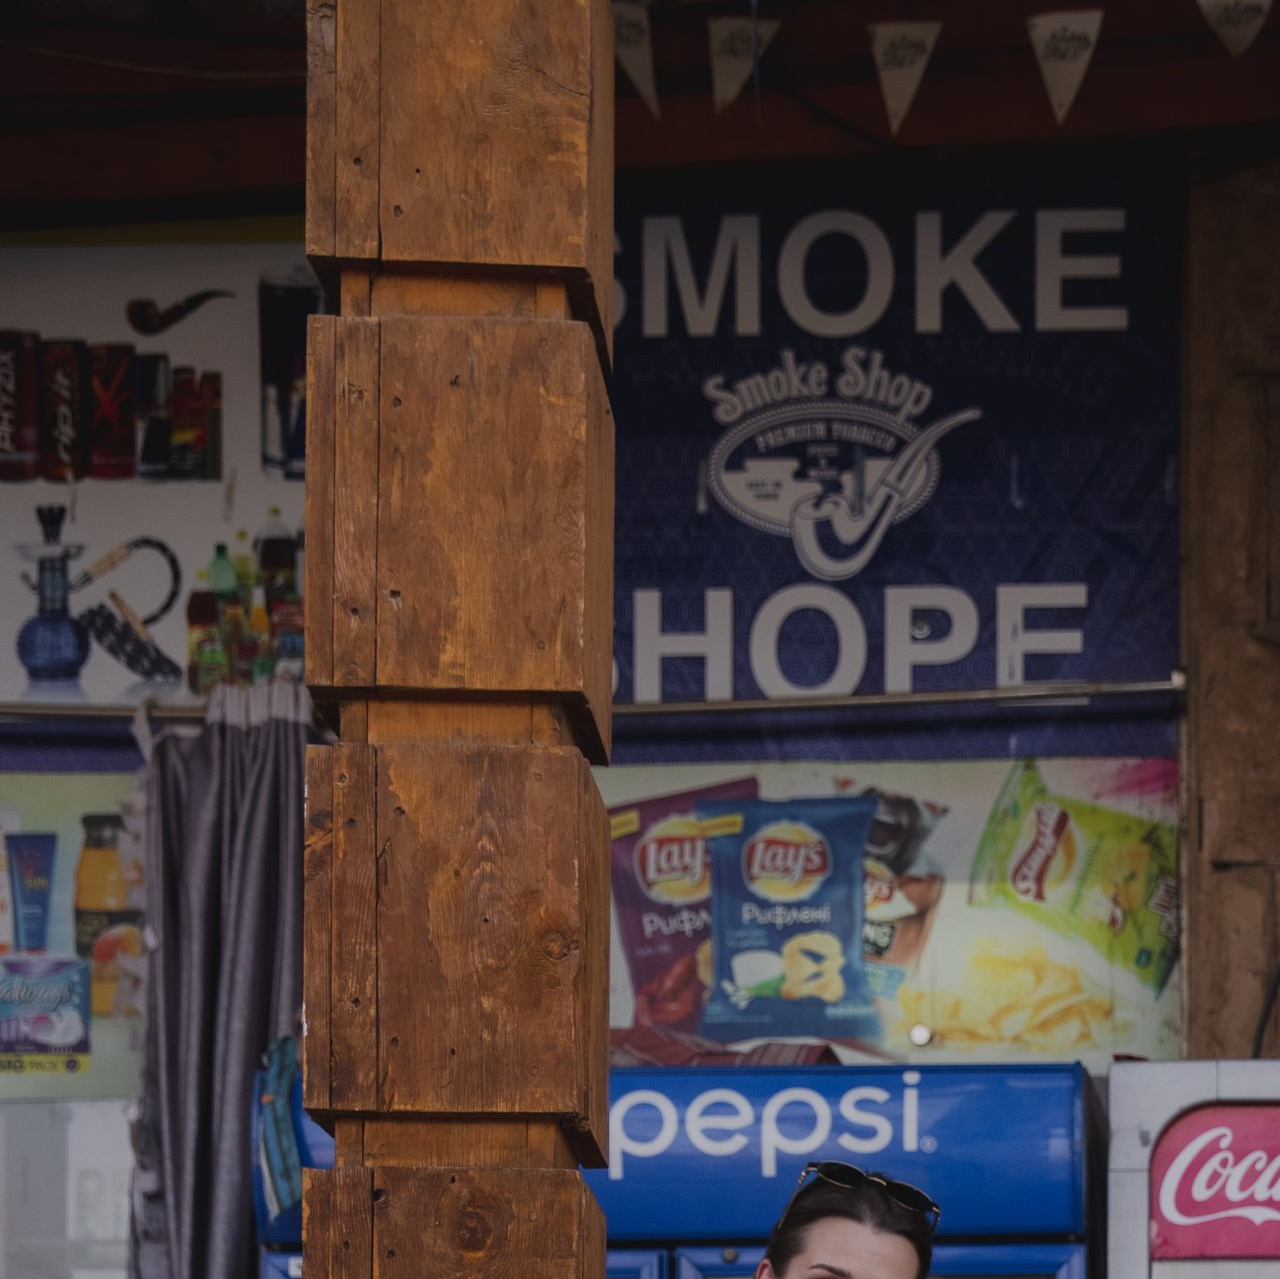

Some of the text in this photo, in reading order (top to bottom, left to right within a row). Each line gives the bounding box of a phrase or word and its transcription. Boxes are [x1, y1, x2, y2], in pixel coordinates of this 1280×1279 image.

[613, 208, 1130, 338] MOKE
[700, 345, 934, 427] Smoke Shop
[613, 582, 1091, 706] HOPE
[645, 837, 712, 886] Lay
[749, 838, 824, 885] Lay's
[641, 907, 713, 940] Рифл
[741, 902, 832, 929] Рифлені
[608, 1070, 921, 1181] pepsi
